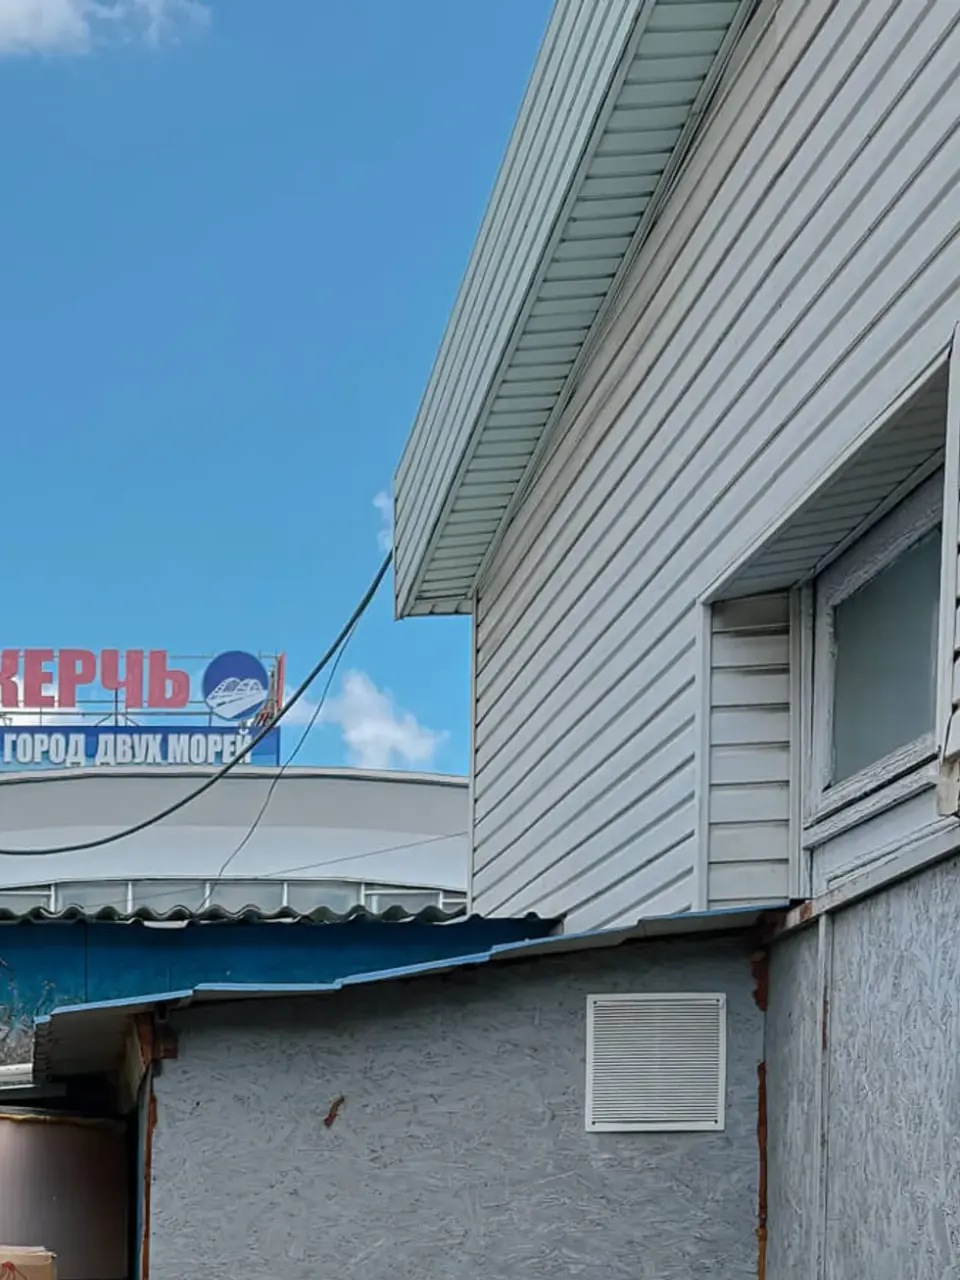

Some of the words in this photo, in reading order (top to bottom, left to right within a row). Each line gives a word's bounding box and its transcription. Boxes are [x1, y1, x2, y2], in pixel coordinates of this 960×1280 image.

[3, 733, 85, 766] ГОРОД
[95, 733, 164, 766] ДВУХ
[168, 729, 252, 765] МОРЕЙ
